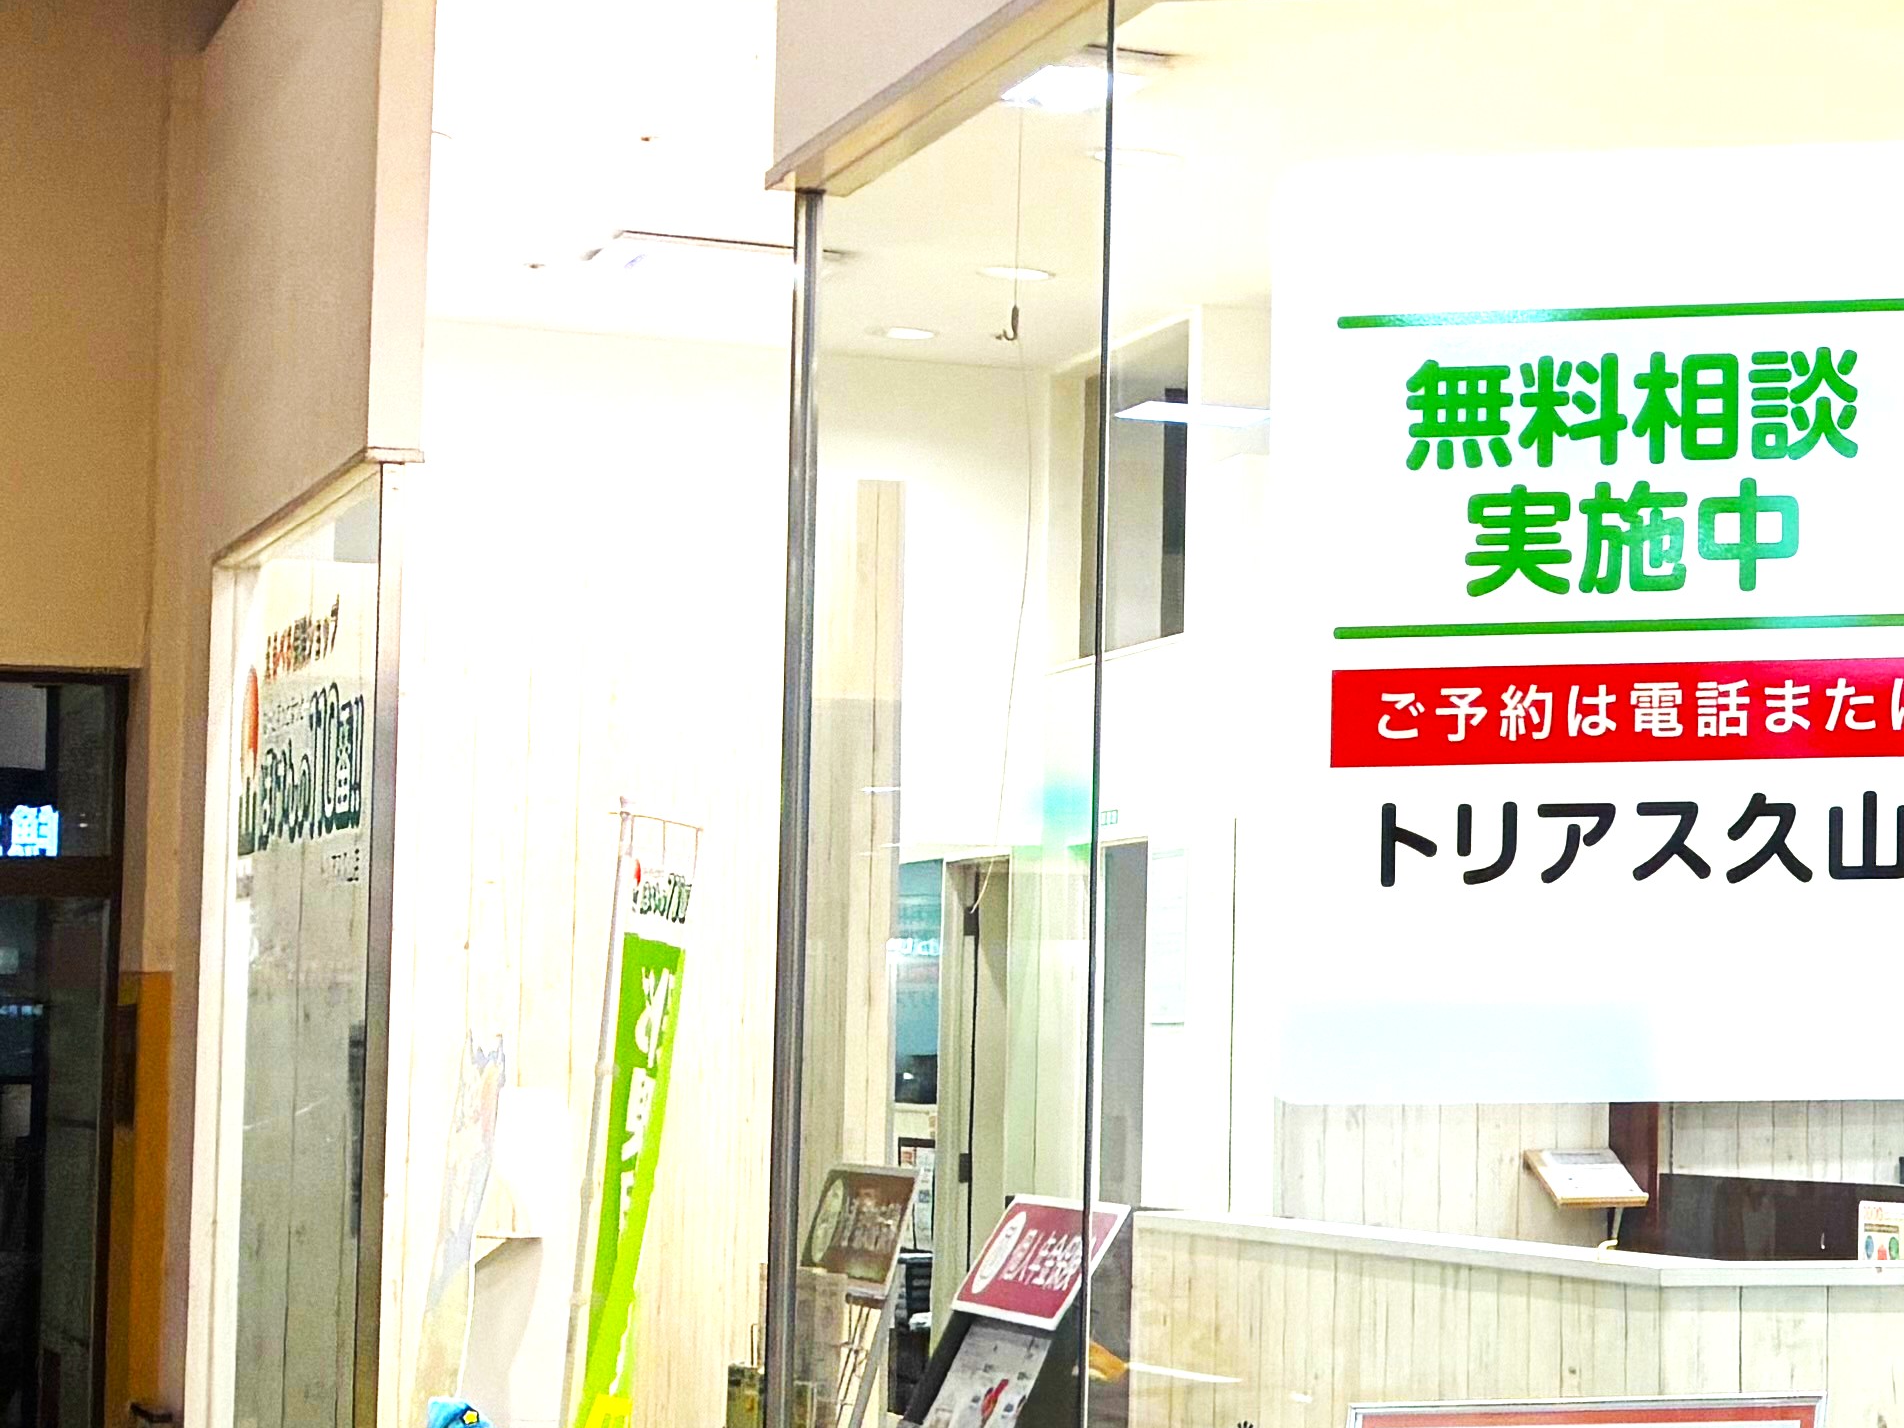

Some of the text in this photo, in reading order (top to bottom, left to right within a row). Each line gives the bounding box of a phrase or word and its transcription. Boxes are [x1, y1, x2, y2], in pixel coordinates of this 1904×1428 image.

[1405, 346, 1859, 471] 無料相談
[1465, 477, 1800, 599] 実施中
